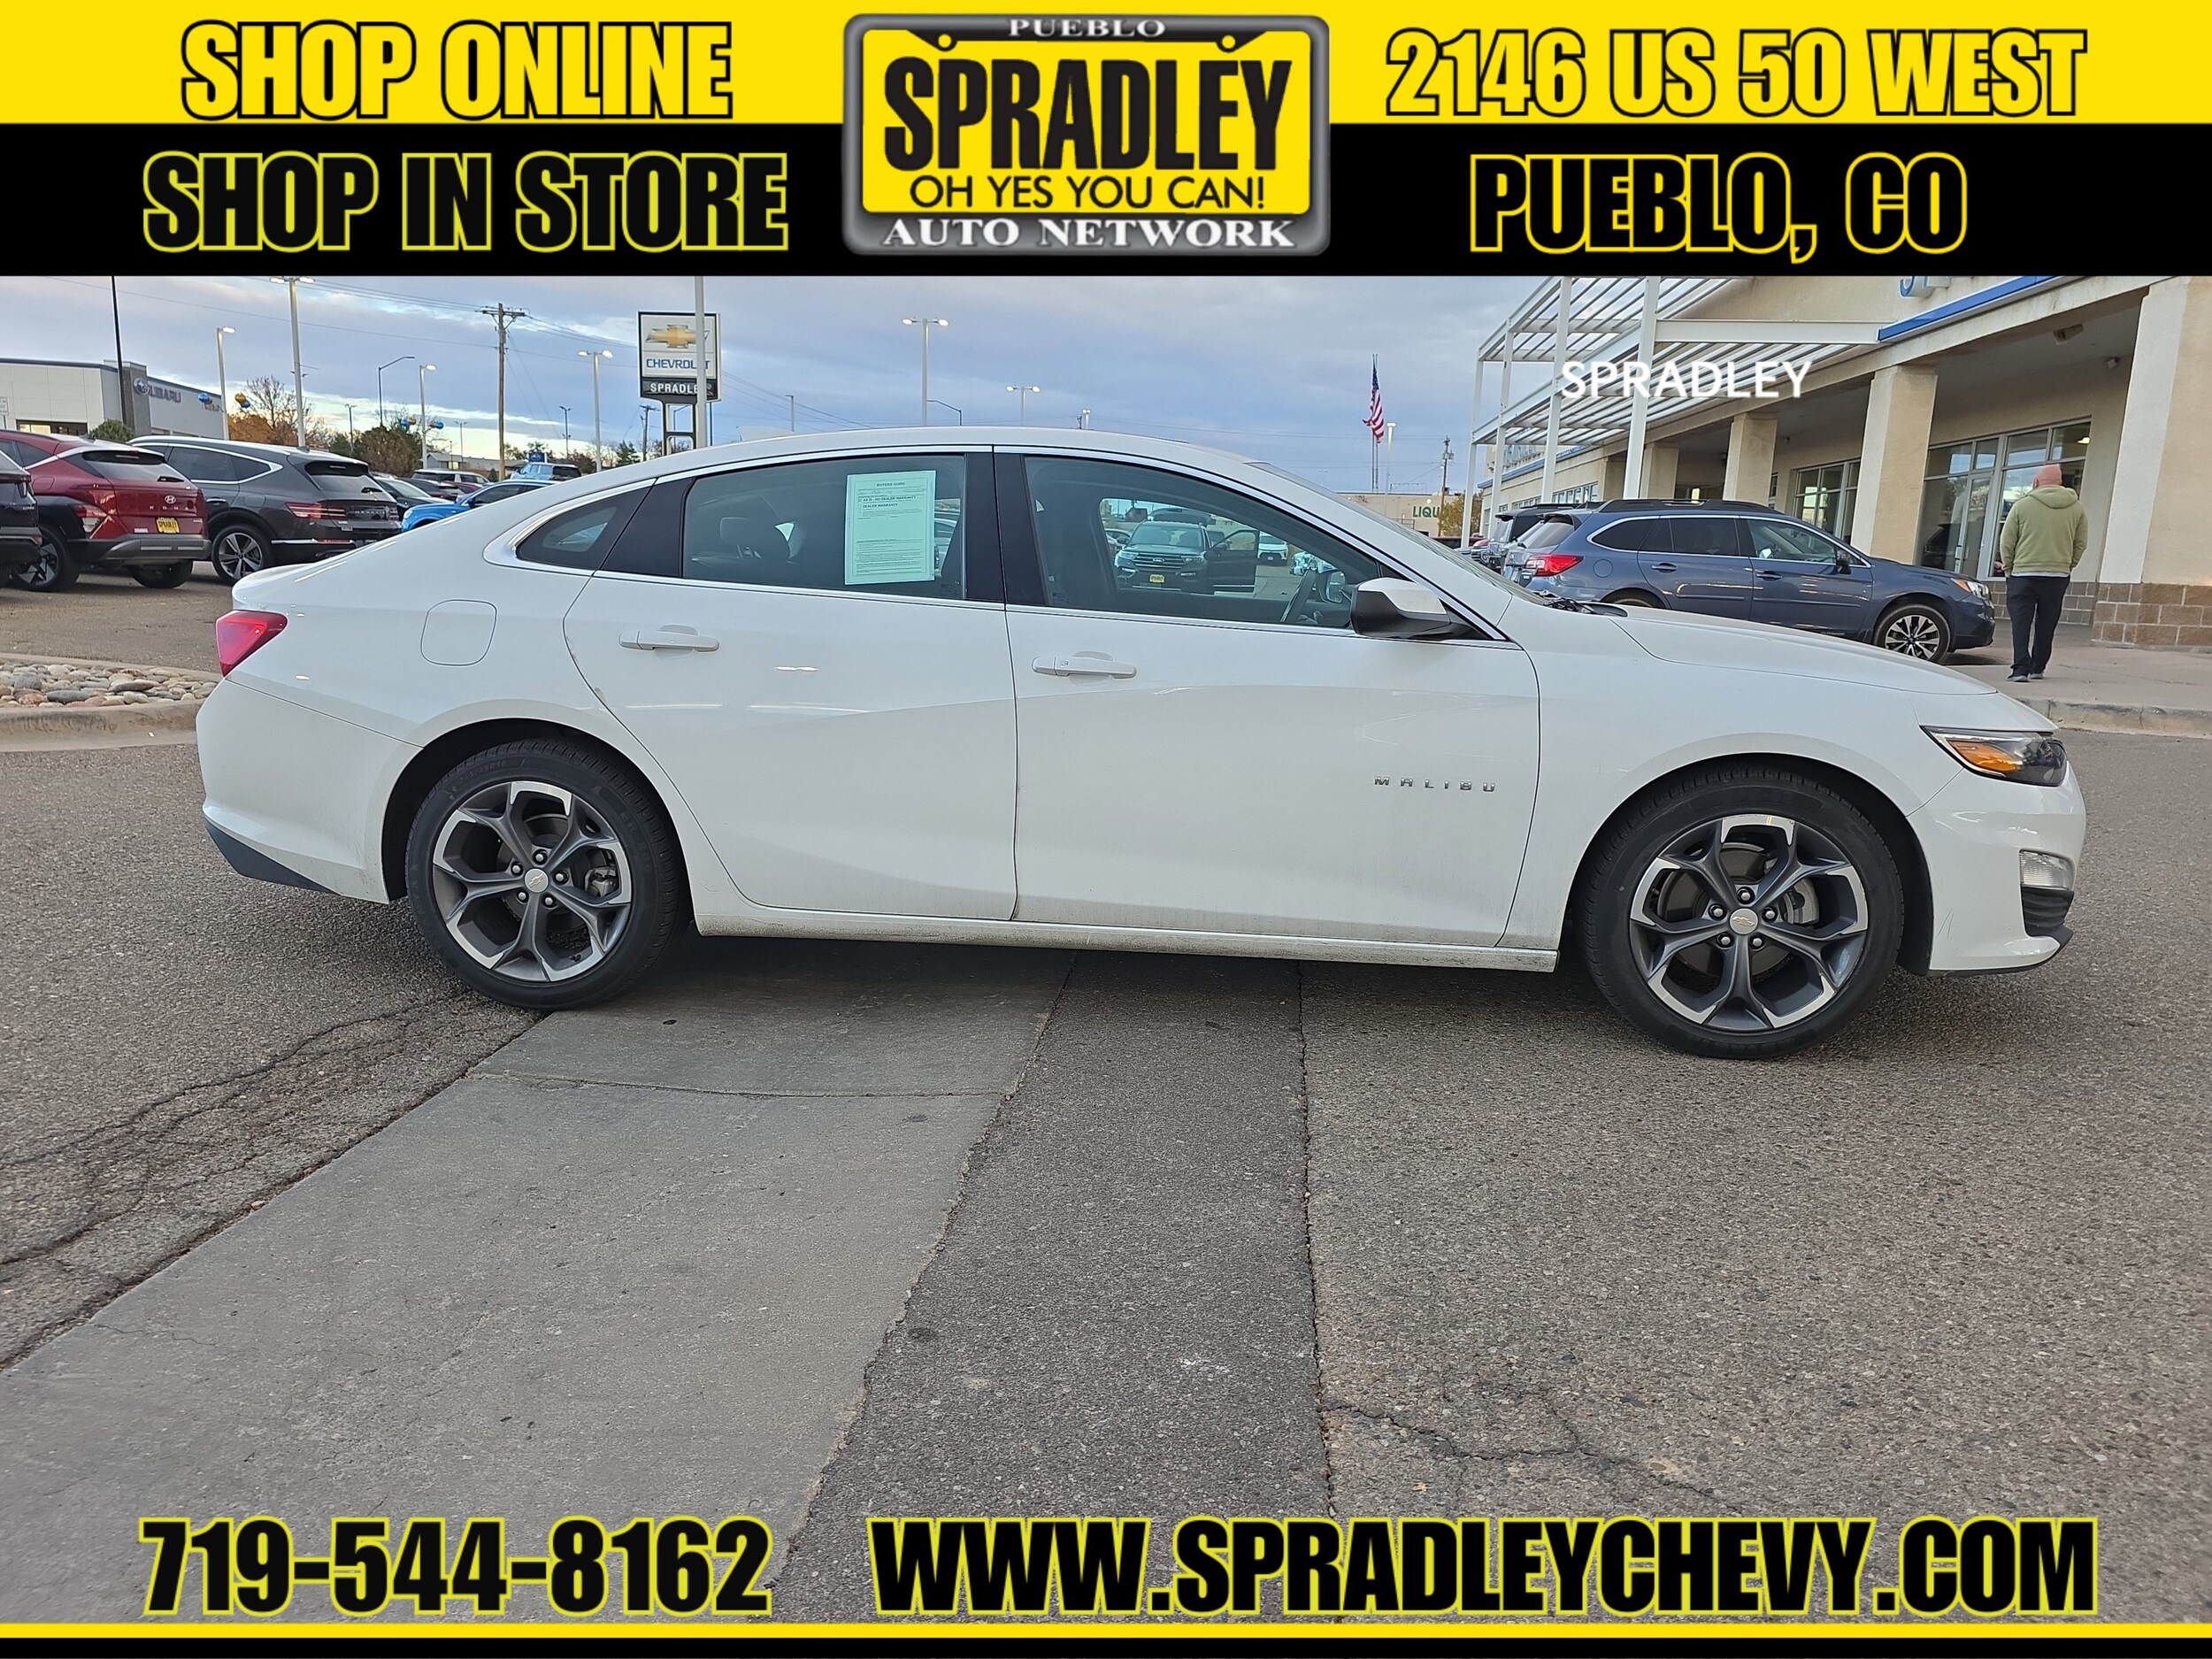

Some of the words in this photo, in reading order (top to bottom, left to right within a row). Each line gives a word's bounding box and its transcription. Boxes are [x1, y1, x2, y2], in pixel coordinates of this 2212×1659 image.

[646, 358, 710, 370] CHEVROLT
[148, 384, 182, 403] UBARU
[649, 383, 699, 394] SPRADLE
[1374, 776, 1495, 793] MALIBU
